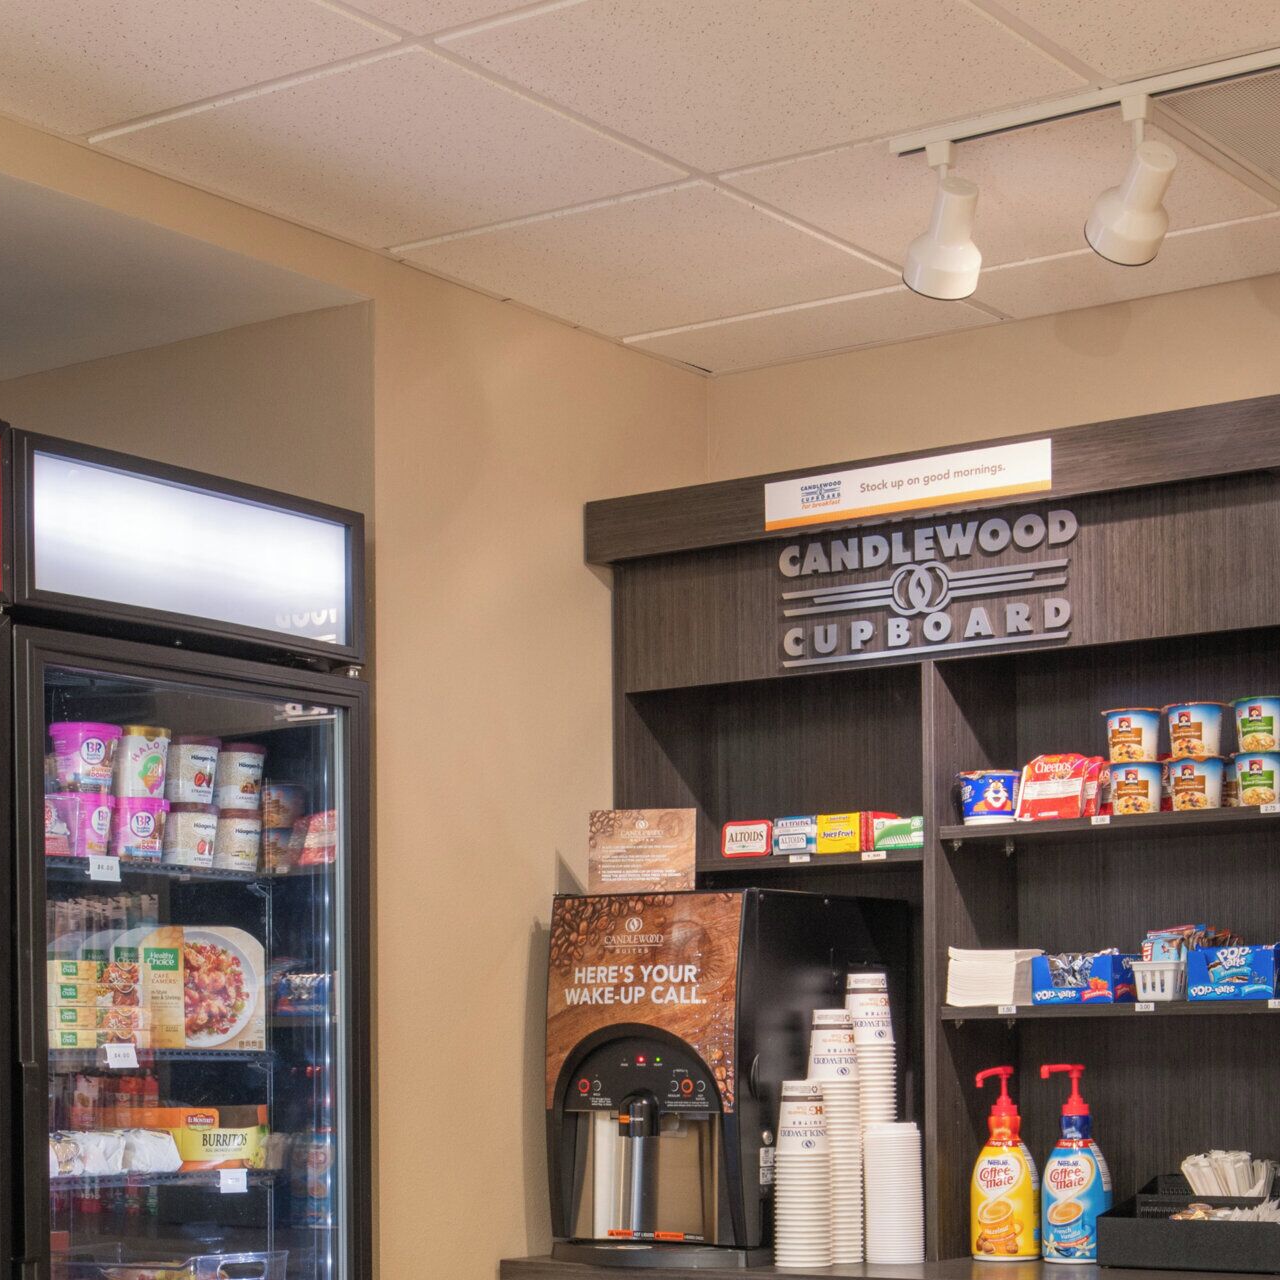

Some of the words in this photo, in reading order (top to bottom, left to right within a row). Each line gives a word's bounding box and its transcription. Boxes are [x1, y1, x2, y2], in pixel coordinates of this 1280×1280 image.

[860, 481, 888, 492] Stock
[891, 479, 905, 489] up
[923, 471, 950, 485] good
[954, 464, 1006, 478] mornings.
[801, 481, 841, 491] CANDLEWOOD
[801, 493, 841, 502] CUPBOARD
[779, 509, 1078, 577] CANDLEWOOD
[783, 598, 1071, 657] CUPBOARD
[728, 831, 764, 842] ALTOIDS
[604, 933, 664, 944] CANDLEWOOD
[150, 952, 174, 960] Healthy
[147, 958, 175, 966] Choice
[575, 966, 634, 983] HERE'S
[639, 964, 696, 982] YOUR
[565, 986, 645, 1005] WAKE-UP
[651, 986, 707, 1004] CALL.
[202, 1134, 247, 1146] BURRITOS
